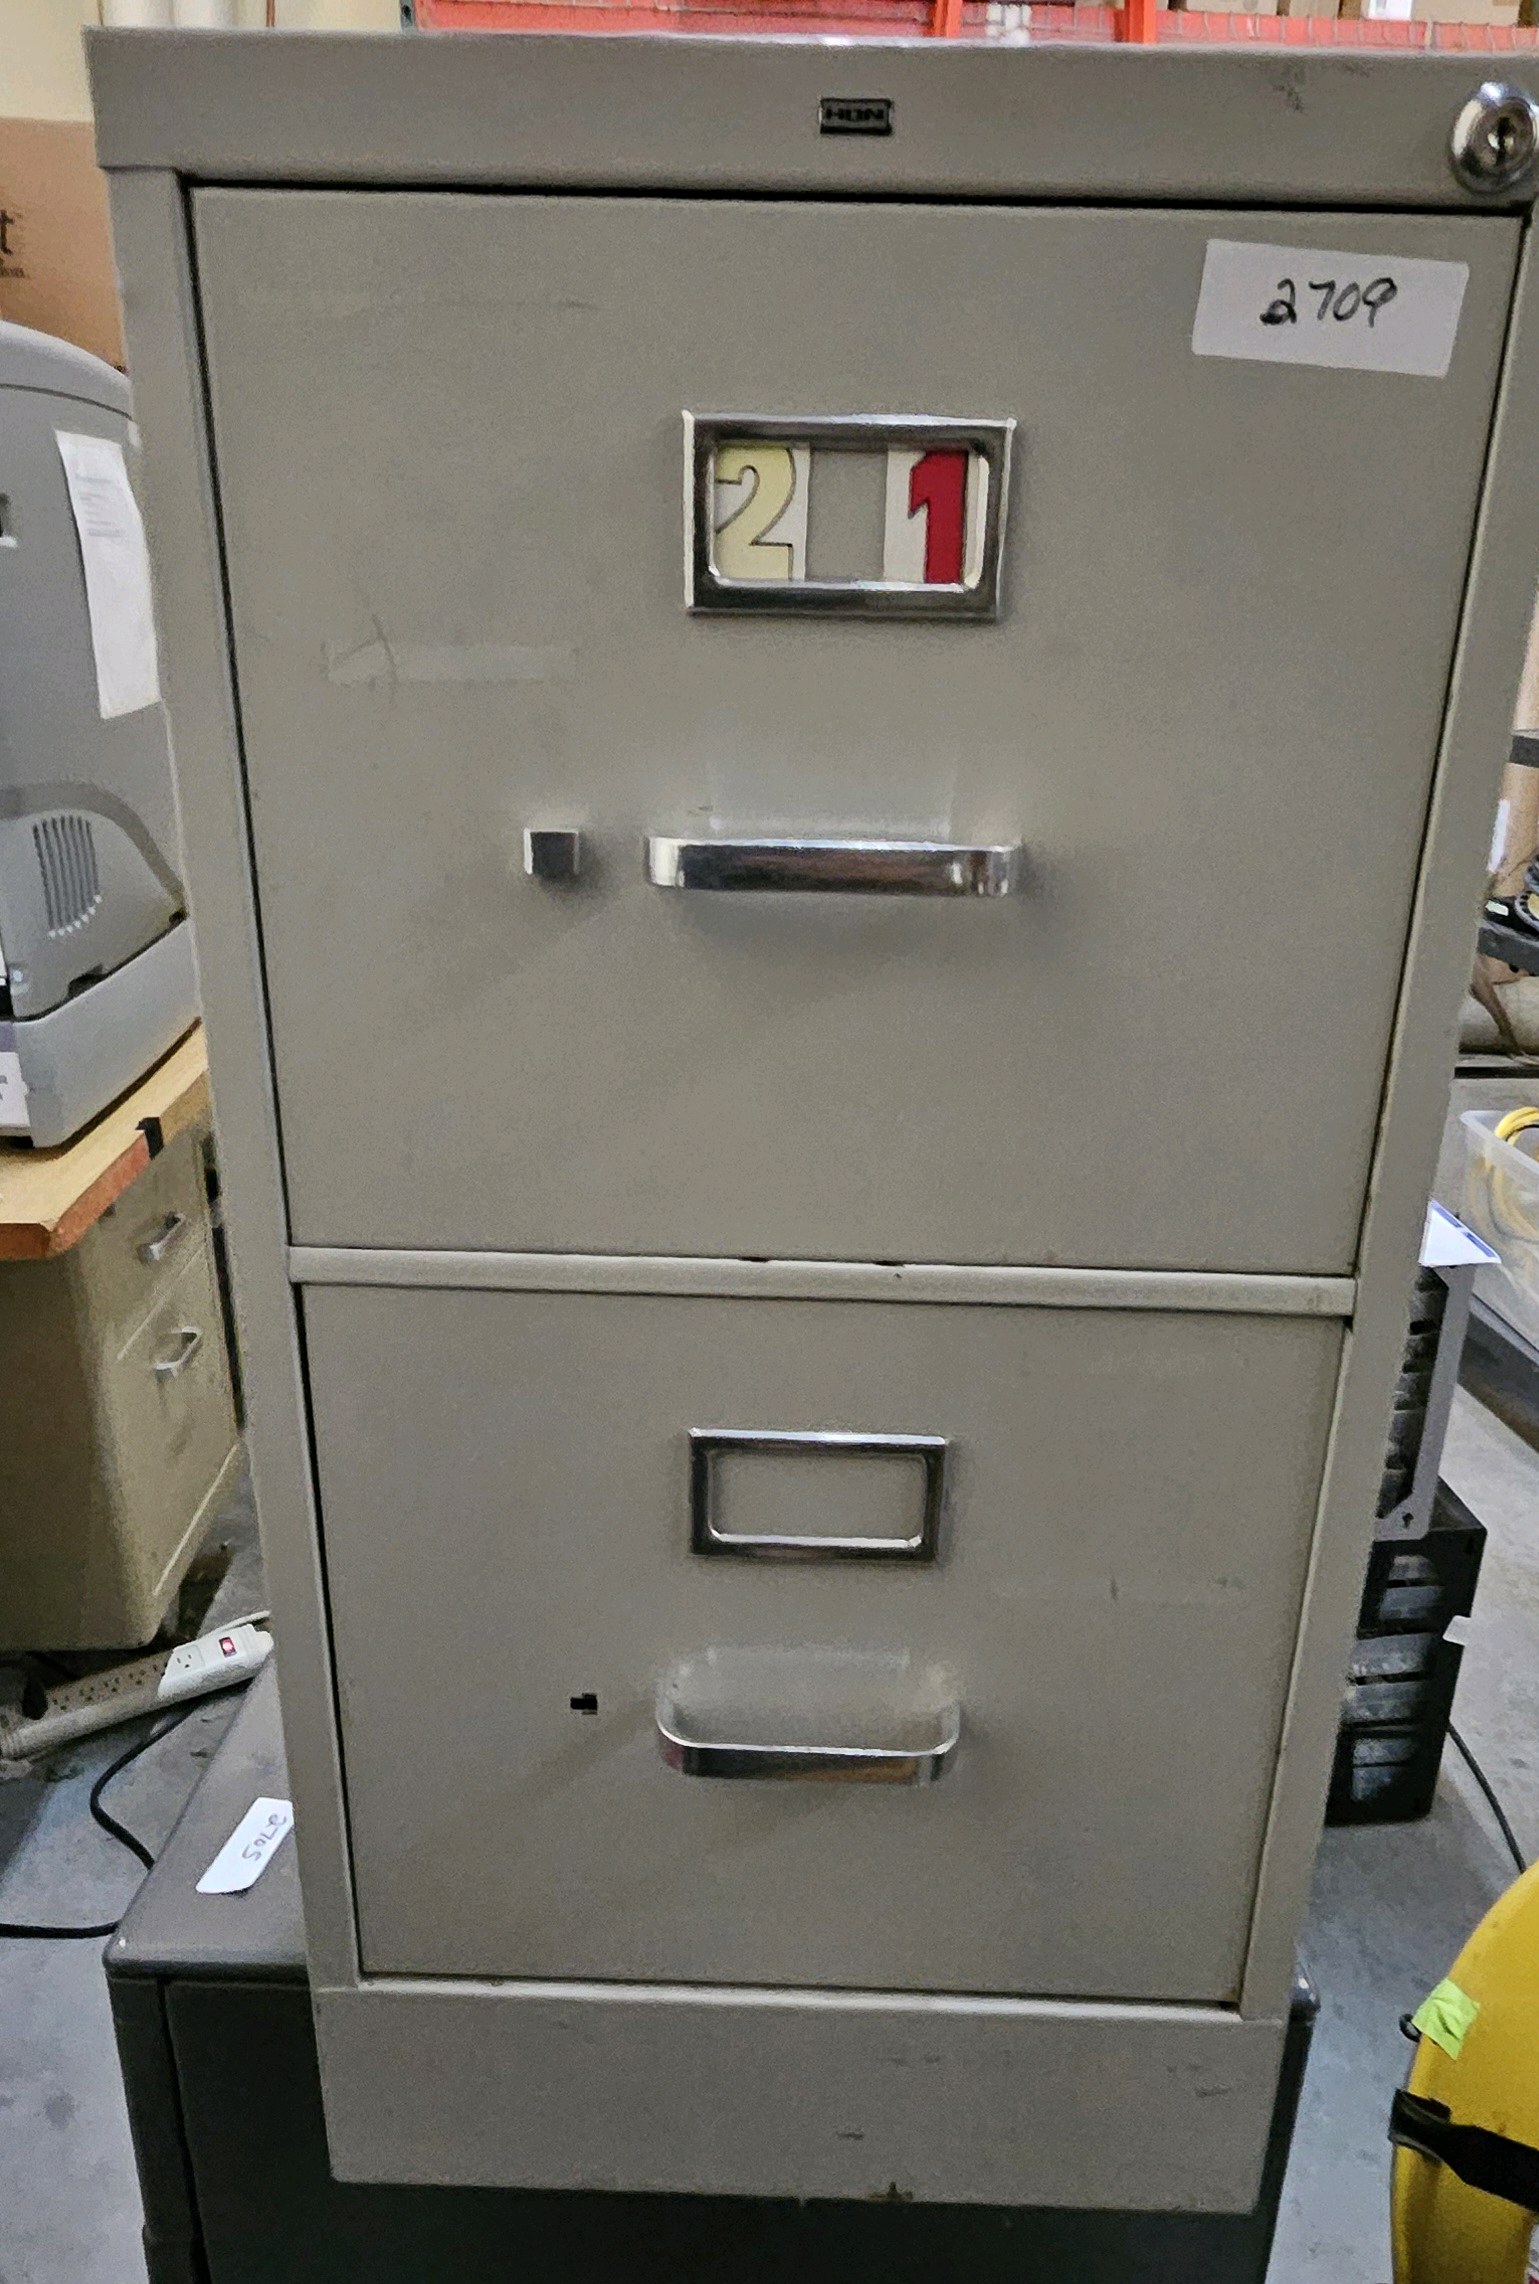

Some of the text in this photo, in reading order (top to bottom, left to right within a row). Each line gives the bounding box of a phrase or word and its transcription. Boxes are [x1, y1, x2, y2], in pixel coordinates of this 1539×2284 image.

[1259, 276, 1398, 328] 2709
[714, 444, 968, 584] 2 1
